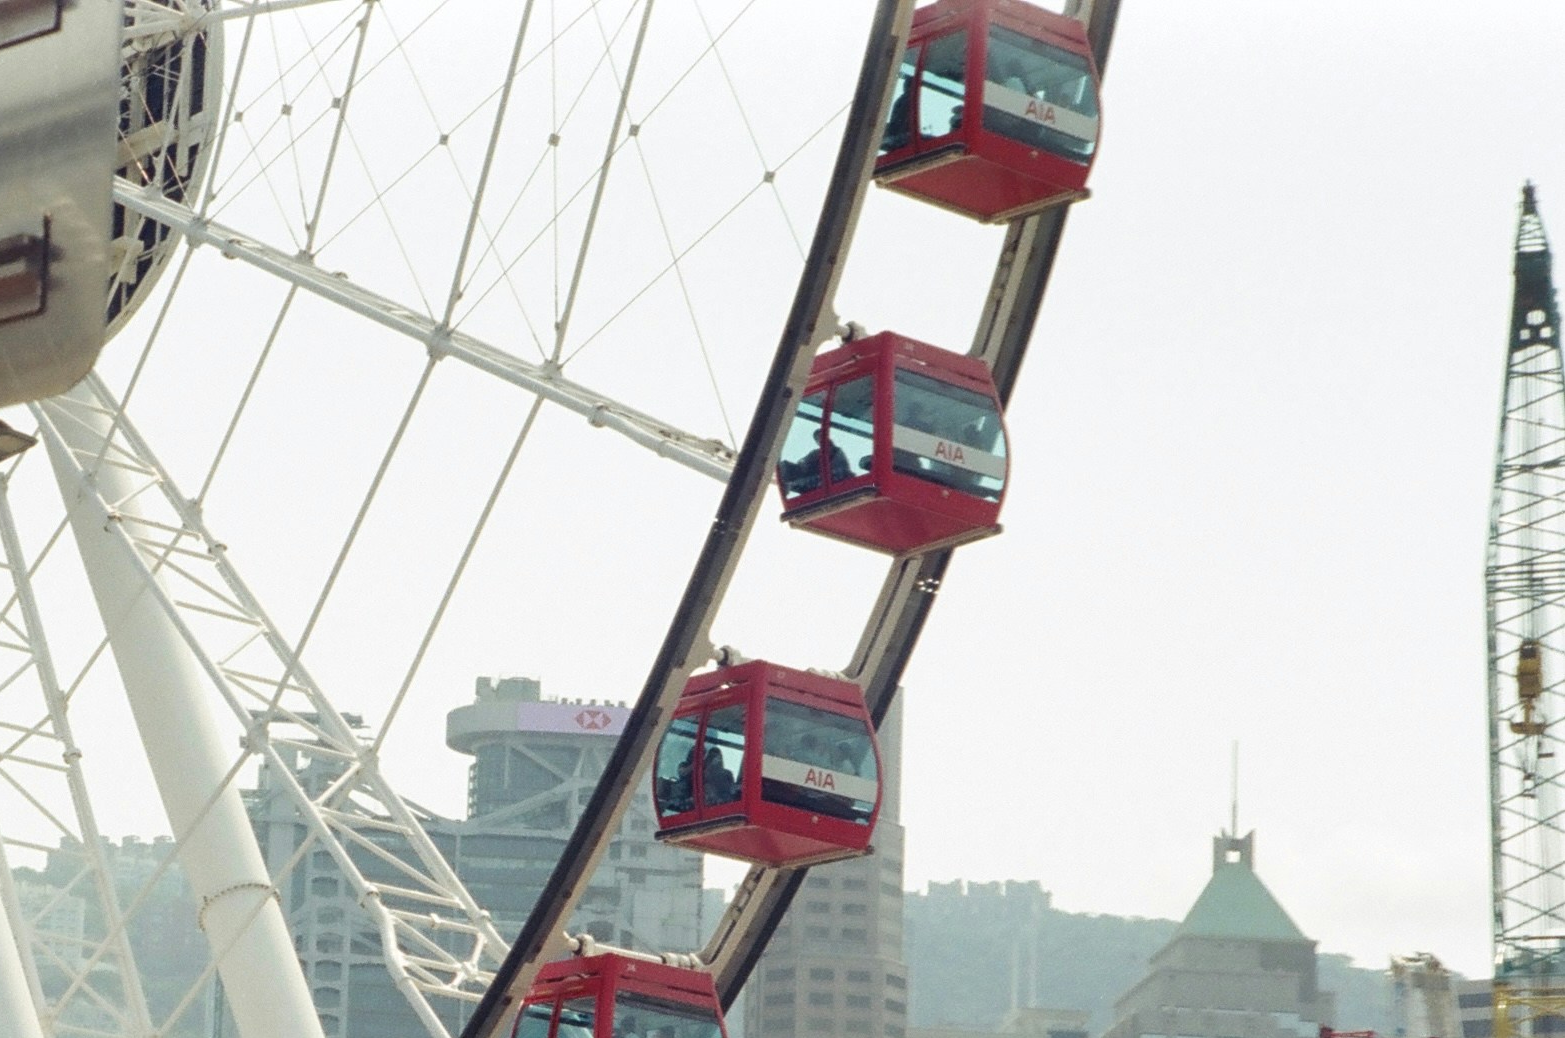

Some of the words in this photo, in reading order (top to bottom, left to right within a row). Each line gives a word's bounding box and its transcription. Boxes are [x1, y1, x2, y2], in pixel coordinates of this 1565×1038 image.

[1024, 99, 1057, 125] AIA
[935, 441, 966, 466] AIA
[804, 767, 836, 790] AIA
